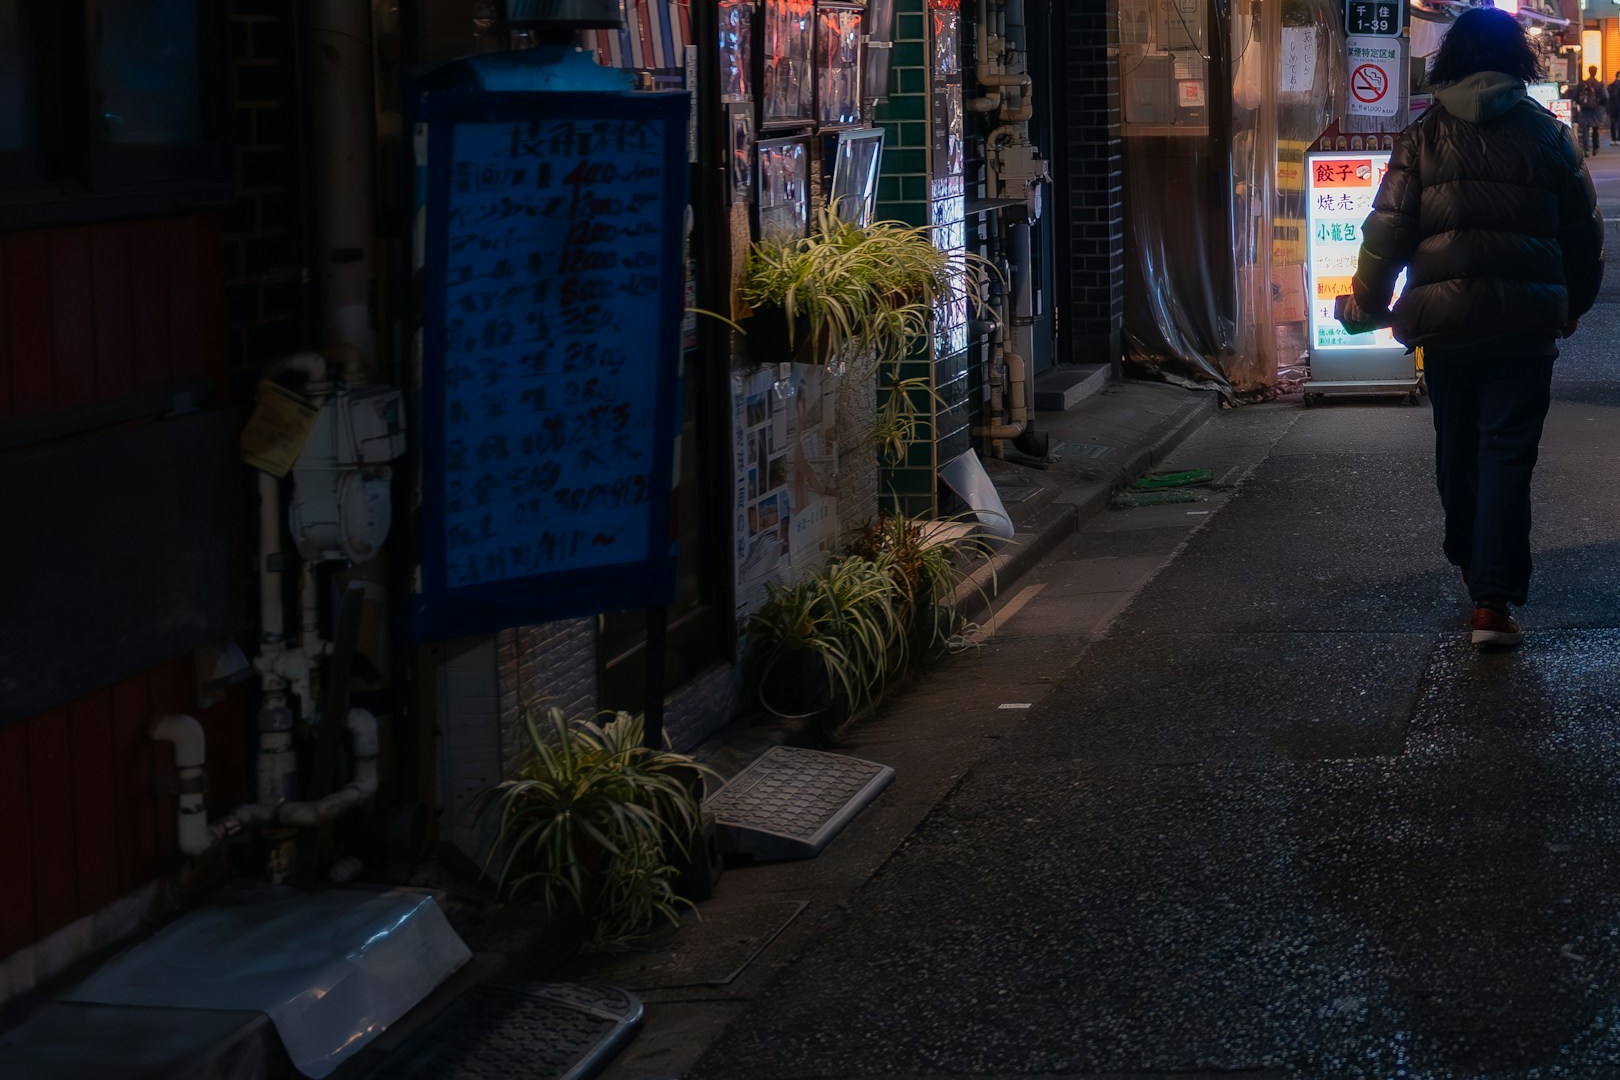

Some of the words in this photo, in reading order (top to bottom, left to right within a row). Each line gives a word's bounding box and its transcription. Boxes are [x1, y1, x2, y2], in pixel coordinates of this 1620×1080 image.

[1356, 5, 1390, 18] 千住
[1356, 20, 1389, 31] 1-39
[1347, 47, 1396, 59] 禁煙特定区域
[1315, 164, 1353, 182] 餃子
[1316, 193, 1354, 211] 焼売
[1317, 222, 1356, 242] 小籠包
